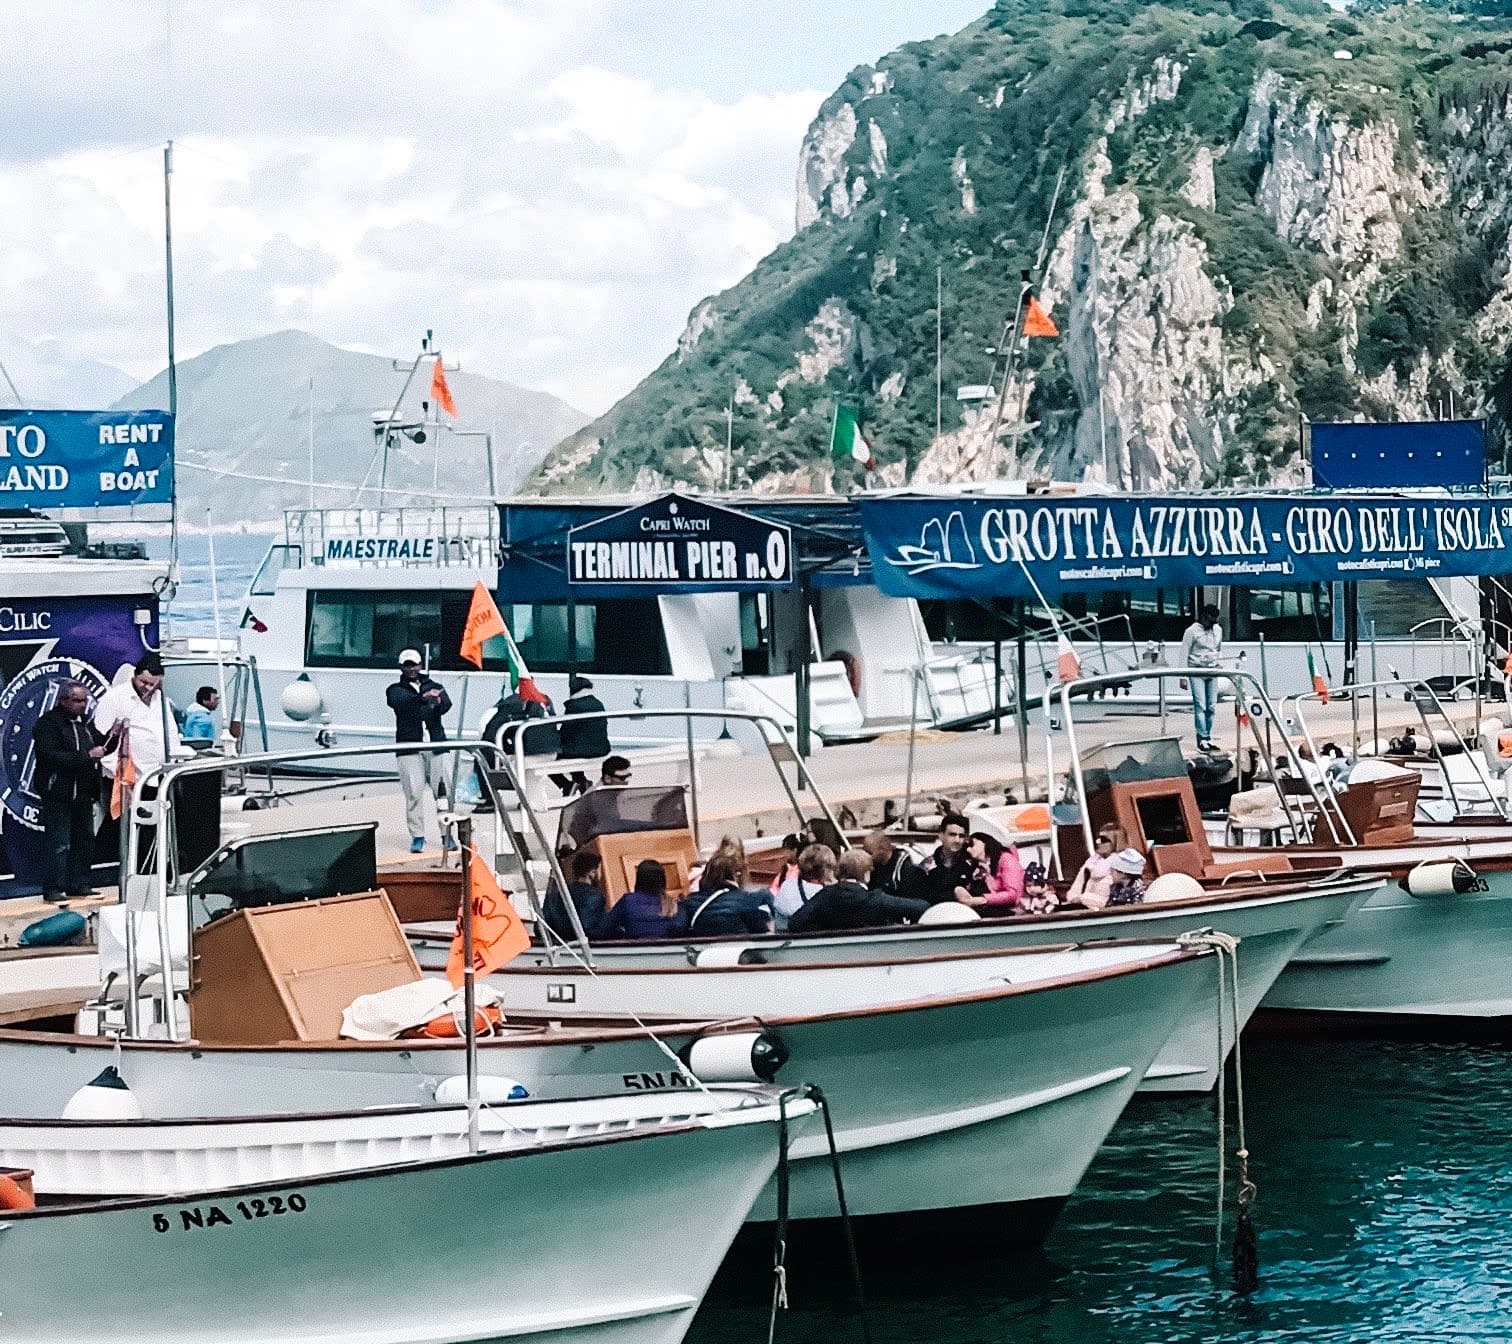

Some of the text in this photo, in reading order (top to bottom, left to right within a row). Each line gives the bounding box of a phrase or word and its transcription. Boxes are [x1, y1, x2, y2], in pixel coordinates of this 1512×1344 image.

[99, 423, 163, 445] RENT
[123, 447, 140, 467] A
[99, 469, 159, 492] BOAT
[640, 516, 710, 531] CAPRI WATCH
[980, 507, 1123, 563] GROTTA
[1131, 507, 1267, 557] AZZURRA
[1286, 506, 1353, 554] GIRO
[1358, 506, 1428, 553] DELL'
[1434, 506, 1505, 550] ISOLA
[327, 538, 434, 559] MAESTRALE
[571, 541, 680, 579] TERMINAL
[686, 541, 738, 579] PIER
[1, 663, 60, 709] CAPRI WATCH
[153, 1193, 307, 1233] 5 NA 1220
